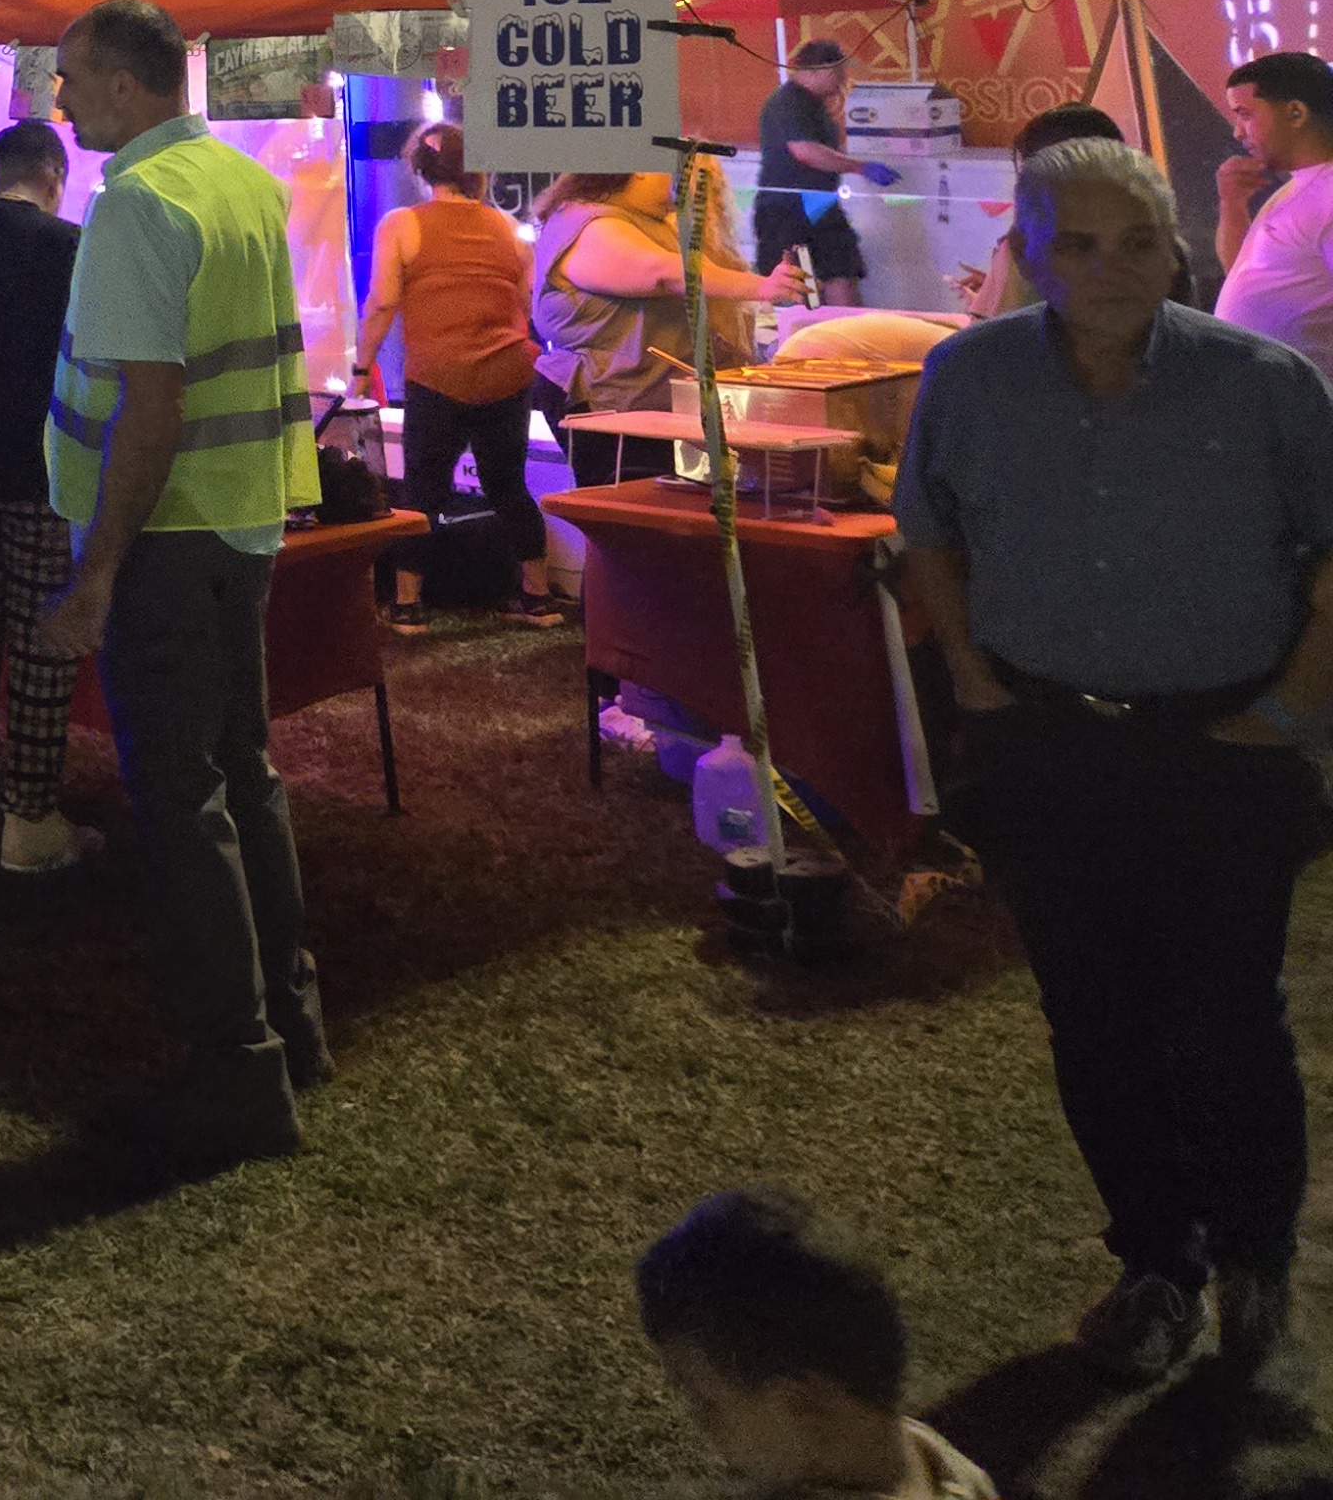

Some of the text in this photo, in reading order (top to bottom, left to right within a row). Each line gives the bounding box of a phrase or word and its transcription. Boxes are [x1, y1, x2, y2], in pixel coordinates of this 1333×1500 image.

[214, 37, 276, 76] CAYMAN
[496, 8, 642, 67] COLD
[496, 71, 643, 128] BEER
